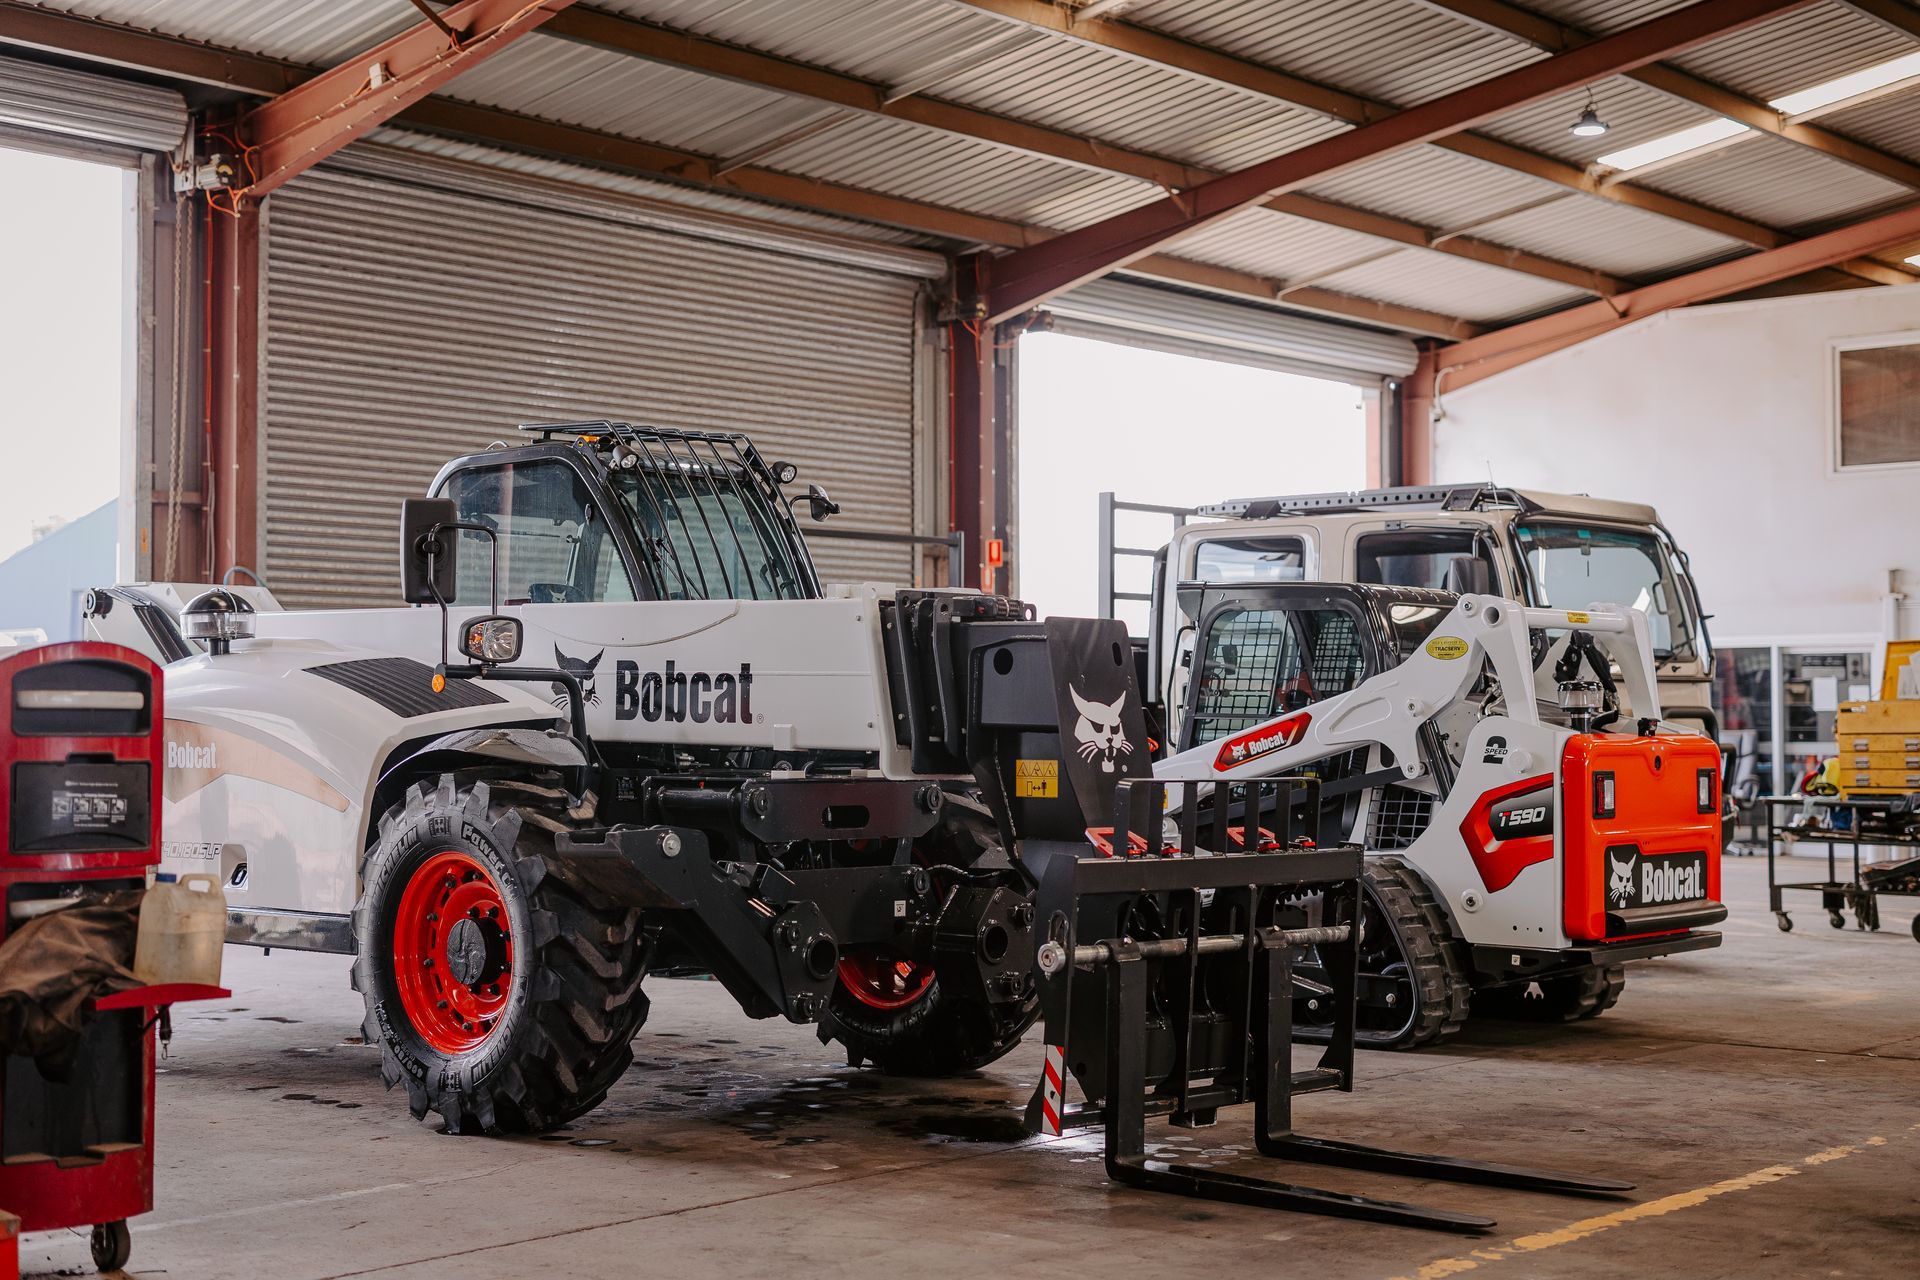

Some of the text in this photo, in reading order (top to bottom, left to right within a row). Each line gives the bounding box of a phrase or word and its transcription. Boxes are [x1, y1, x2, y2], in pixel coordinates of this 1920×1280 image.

[615, 660, 753, 724] Bobcat
[168, 741, 217, 769] Bobcat
[1248, 731, 1285, 755] Bobcat
[1482, 735, 1507, 764] 2
[1484, 747, 1508, 755] SPEED
[1498, 806, 1546, 827] T590
[462, 824, 505, 874] Power
[1642, 860, 1701, 904] Bobcat
